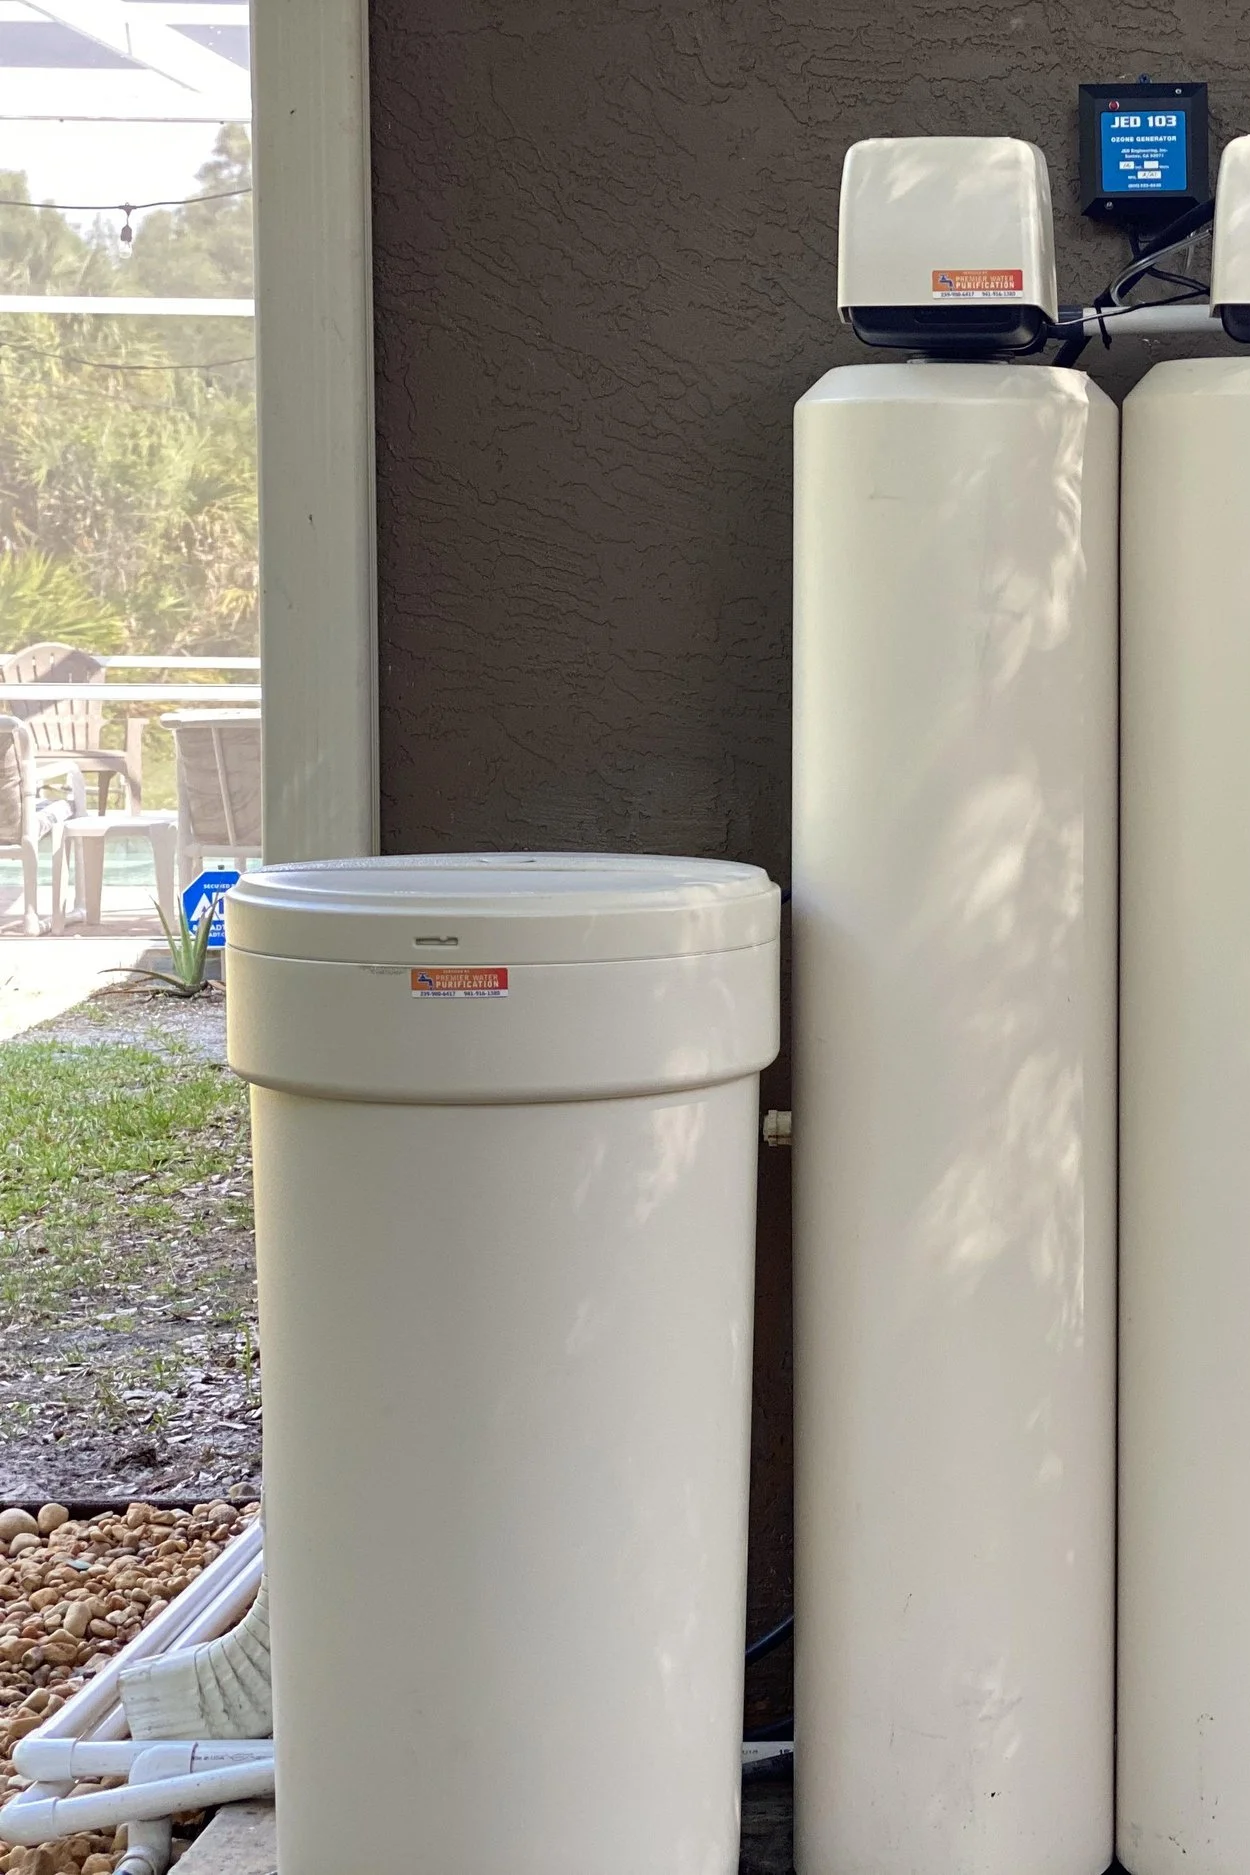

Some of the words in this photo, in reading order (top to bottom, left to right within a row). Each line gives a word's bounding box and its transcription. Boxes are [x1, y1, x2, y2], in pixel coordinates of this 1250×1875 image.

[1110, 116, 1141, 128] JED
[1147, 115, 1177, 127] 103
[435, 980, 499, 988] PURIFICATION
